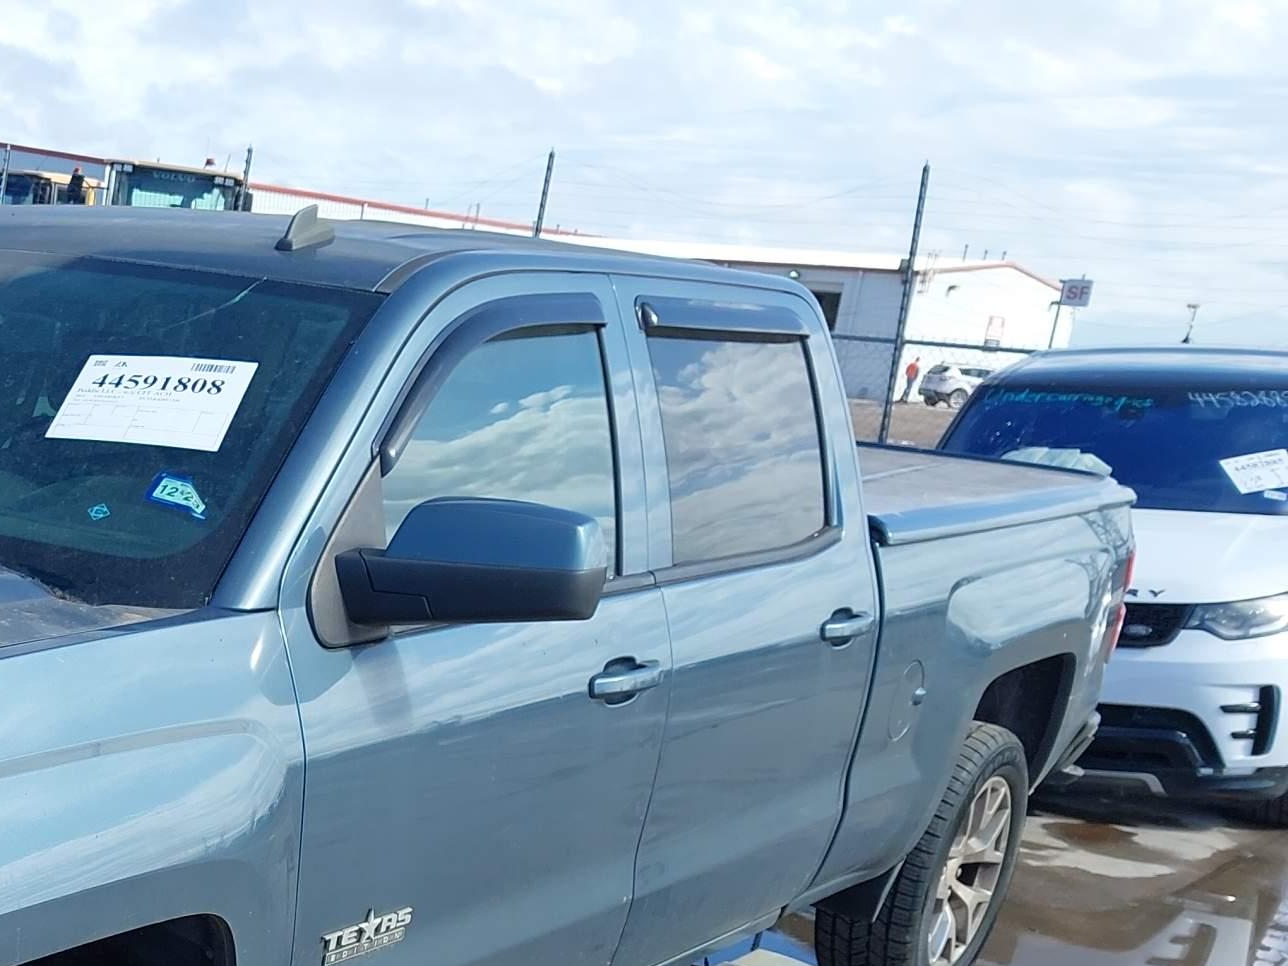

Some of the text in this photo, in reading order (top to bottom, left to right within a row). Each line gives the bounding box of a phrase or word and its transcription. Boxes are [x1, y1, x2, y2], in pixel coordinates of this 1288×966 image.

[92, 373, 226, 395] 44591808
[322, 906, 414, 952] TEXAS
[329, 931, 403, 963] EDITION
